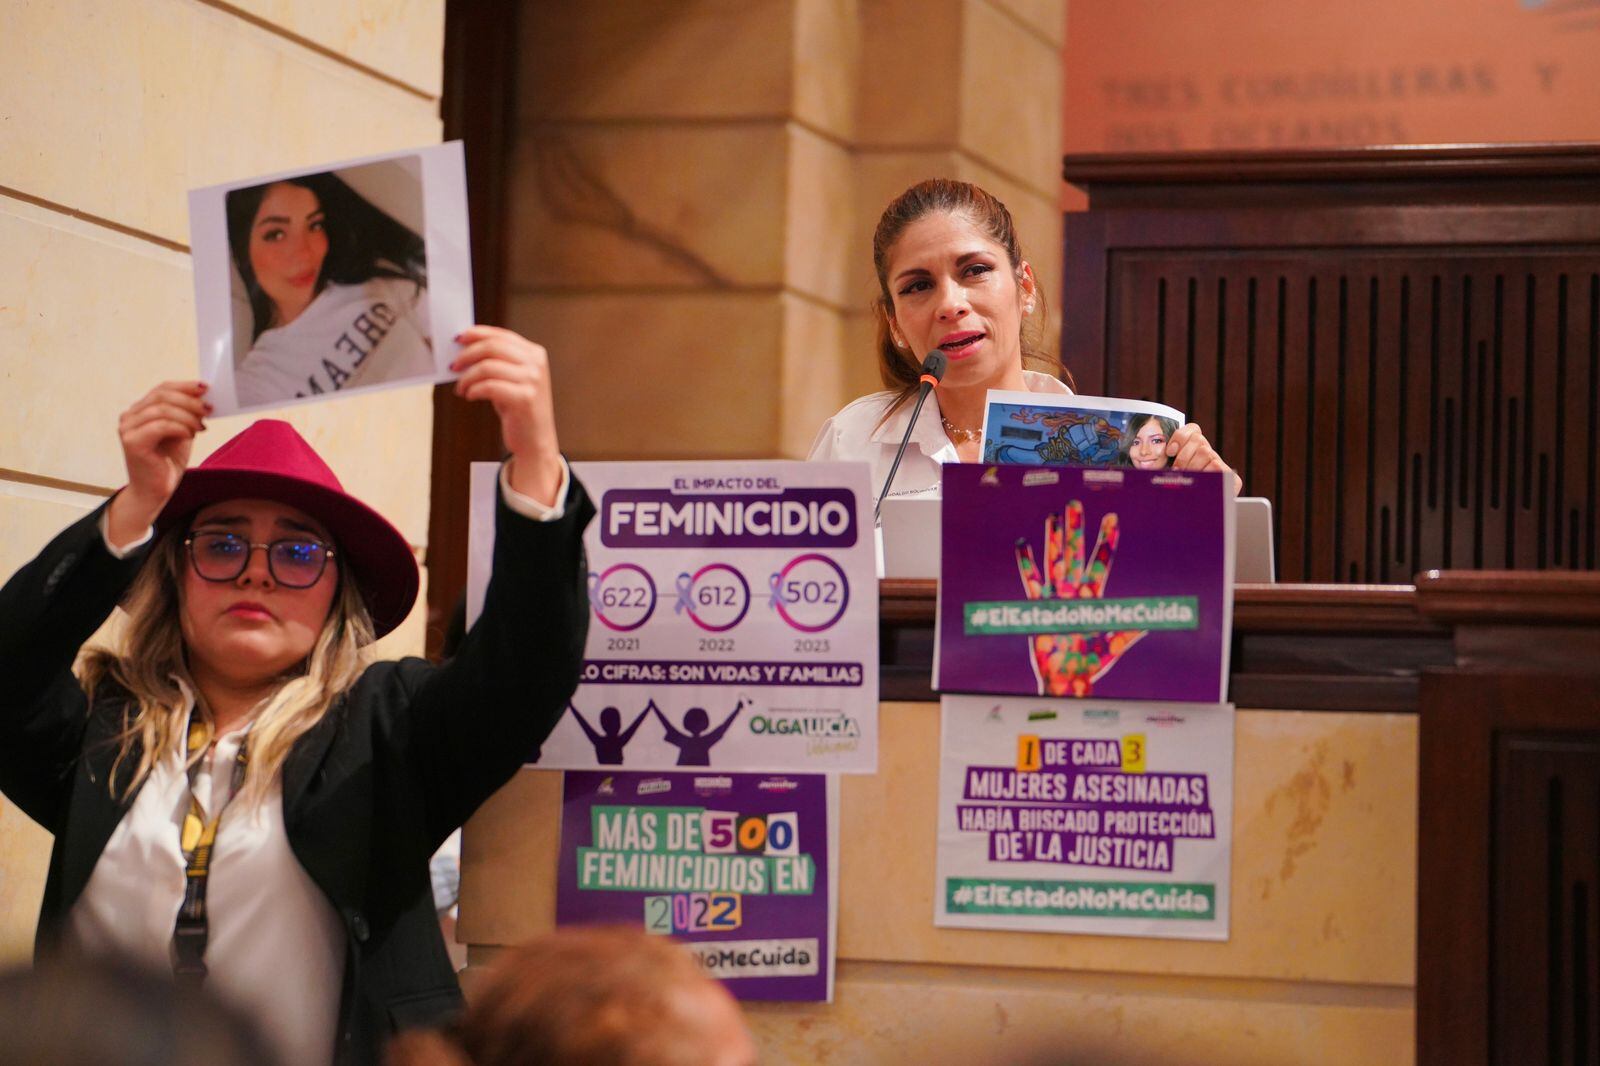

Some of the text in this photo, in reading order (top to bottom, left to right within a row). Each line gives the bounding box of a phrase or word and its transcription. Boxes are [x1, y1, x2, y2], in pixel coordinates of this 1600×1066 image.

[674, 478, 781, 489] EL IMPACTO DEL
[609, 501, 850, 536] FEMINICIDIO
[603, 588, 646, 607] 622
[699, 586, 736, 606] 612
[786, 582, 838, 604] 502
[970, 601, 1194, 628] #ElEstadoNoMeCuida
[607, 639, 640, 651] 2021
[699, 639, 735, 652] 2022
[794, 640, 830, 653] 2023
[602, 664, 667, 681] CIFRAS:
[669, 665, 704, 681] SON
[707, 665, 760, 682] VIDAS
[764, 666, 776, 682] Y
[779, 666, 861, 683] FAMILIAS
[1044, 741, 1067, 765] DE
[1072, 742, 1120, 766] CADA
[1125, 740, 1141, 764] 3
[970, 771, 1206, 805] MUJERES ASESINADAS
[599, 808, 793, 850] MÁS DE 500
[961, 806, 1212, 836] HABÍA BUSCADO PROTECCIÓN
[995, 832, 1169, 870] DE LA JUSTICIA
[582, 851, 812, 892] FEMINICIDIOS EN
[953, 883, 1210, 912] #ElEstadoNoMeCuida
[651, 896, 737, 929] 2022
[691, 946, 811, 969] NoMeCuida
